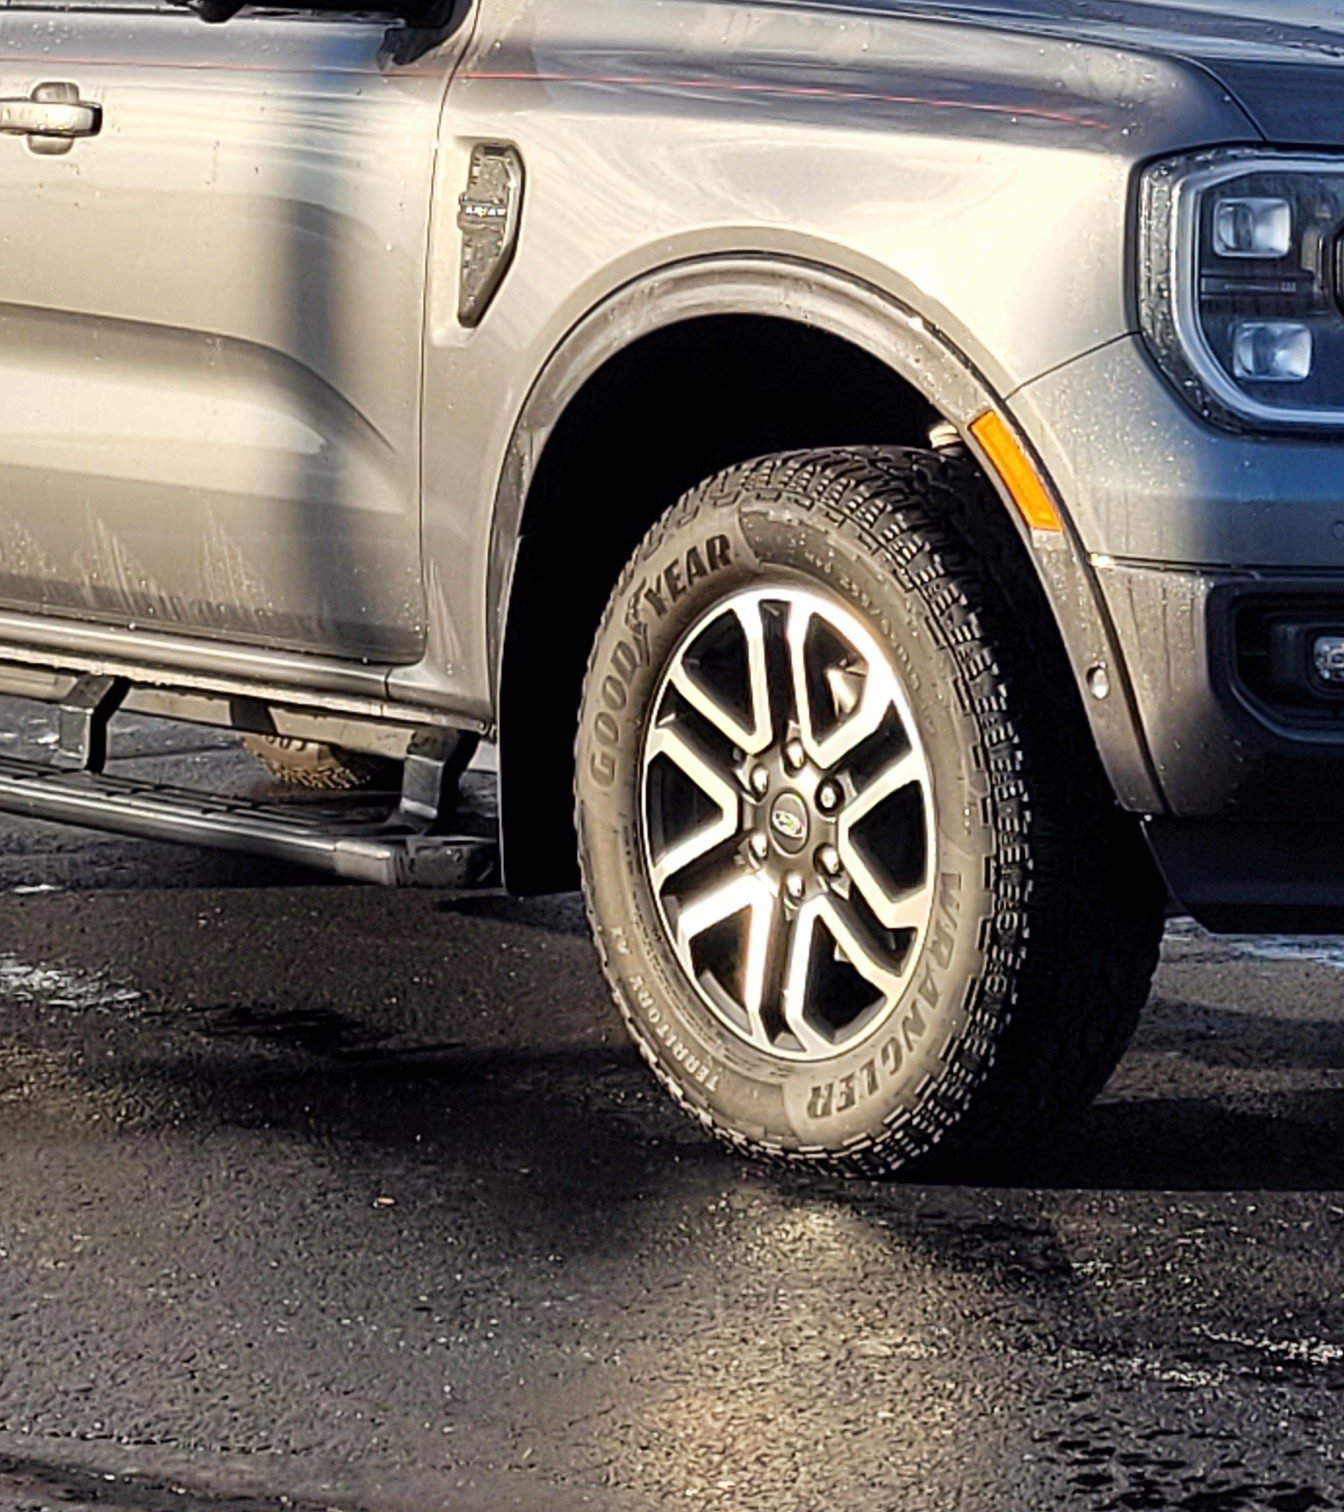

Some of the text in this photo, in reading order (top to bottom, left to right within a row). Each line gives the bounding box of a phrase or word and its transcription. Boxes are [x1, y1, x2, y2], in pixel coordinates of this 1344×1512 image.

[590, 533, 732, 788] GOODYEAR
[629, 975, 719, 1092] TERRITORY
[807, 873, 962, 1120] WRANGLER
